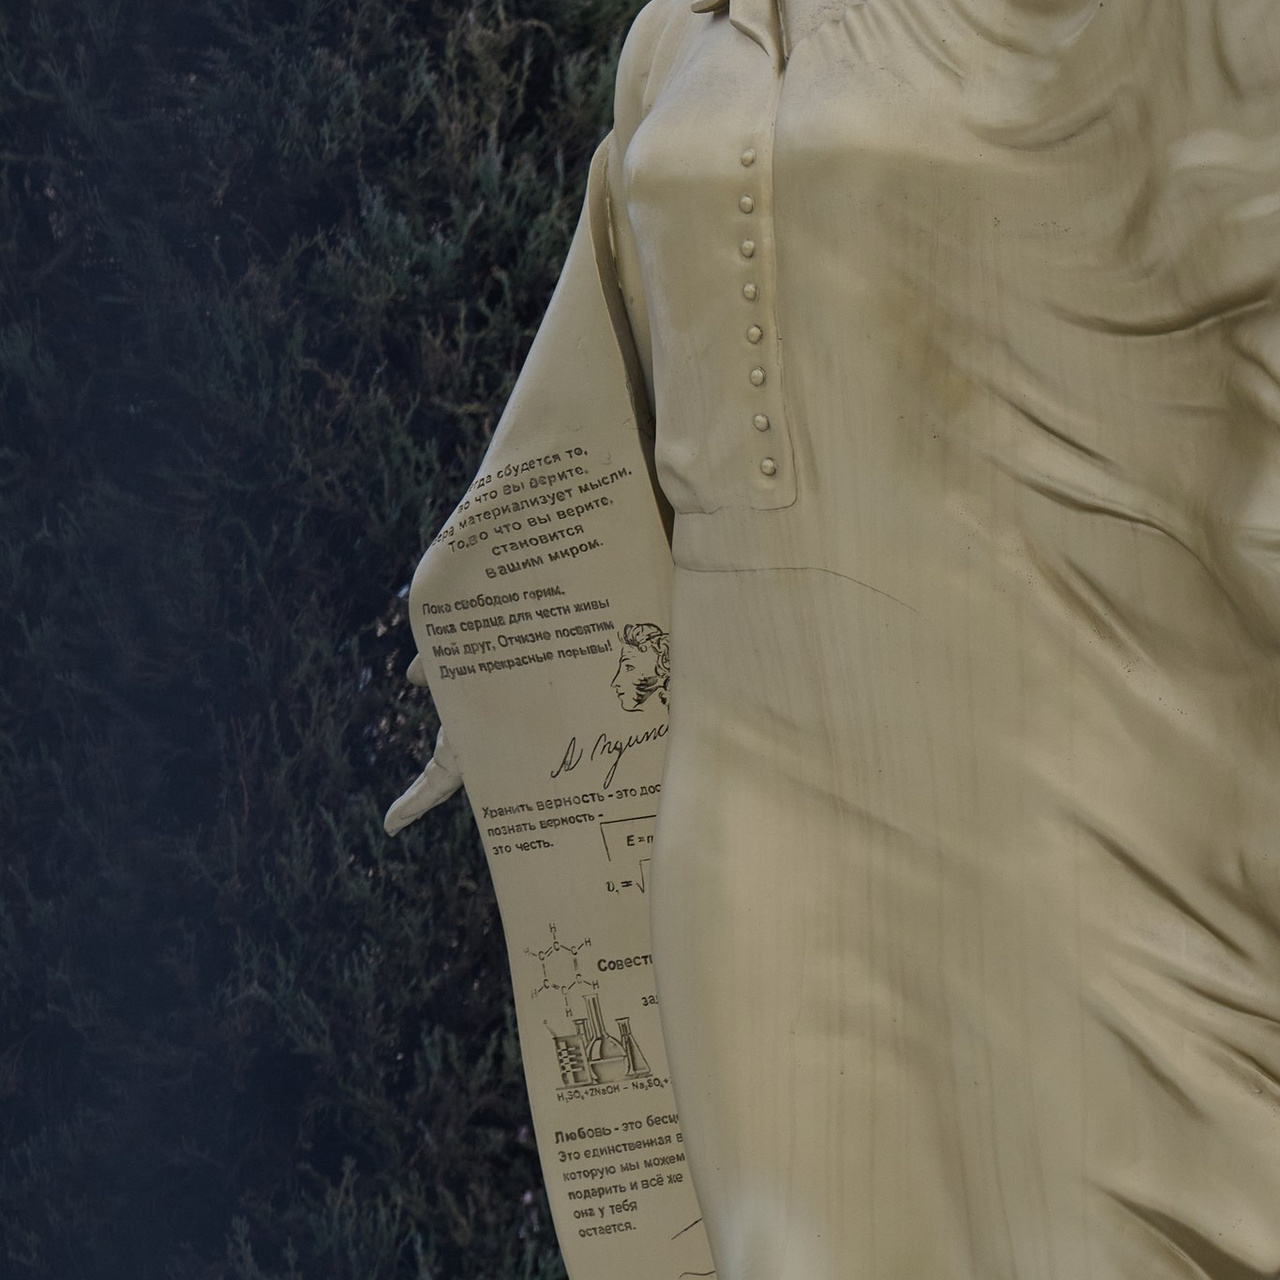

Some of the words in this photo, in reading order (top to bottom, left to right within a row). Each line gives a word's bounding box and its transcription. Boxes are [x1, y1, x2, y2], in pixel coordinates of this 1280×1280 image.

[497, 453, 561, 479] сбудется
[565, 447, 588, 459] то,
[459, 488, 573, 531] материализует
[578, 467, 632, 494] мысли.
[474, 490, 498, 504] что
[493, 521, 522, 535] что
[527, 513, 551, 527] вы
[491, 524, 584, 556] становится
[548, 538, 603, 562] миром.
[422, 603, 451, 615] Пока
[454, 592, 520, 610] свободою
[426, 623, 457, 637] Пока
[460, 615, 506, 632] сердца
[509, 611, 533, 625] для
[535, 605, 571, 619] чести
[573, 599, 610, 613] живы
[432, 642, 460, 657] Мой
[497, 630, 551, 647] Отчизне
[555, 620, 615, 638] посвятим
[439, 664, 476, 680] Души
[478, 651, 554, 674] прекрасные
[557, 639, 613, 659] порывы!
[482, 804, 534, 819] Хранить
[536, 792, 605, 811] верность
[616, 788, 637, 799] это
[487, 822, 536, 837] познать
[539, 813, 595, 829] верность
[492, 845, 512, 856] это
[515, 839, 554, 852] честь.
[554, 1125, 612, 1145] Любовь
[621, 1120, 643, 1132] это
[558, 1150, 581, 1163] Это
[583, 1135, 672, 1159] единственная
[562, 1163, 616, 1182] которую
[620, 1161, 640, 1173] мы
[643, 1152, 686, 1169] можем
[567, 1183, 627, 1200] подарить
[629, 1180, 638, 1191] и
[640, 1174, 664, 1189] всё
[667, 1172, 683, 1185] же
[573, 1207, 595, 1220] она
[597, 1206, 605, 1219] у
[609, 1198, 638, 1215] тебя
[578, 1221, 637, 1238] остается.
